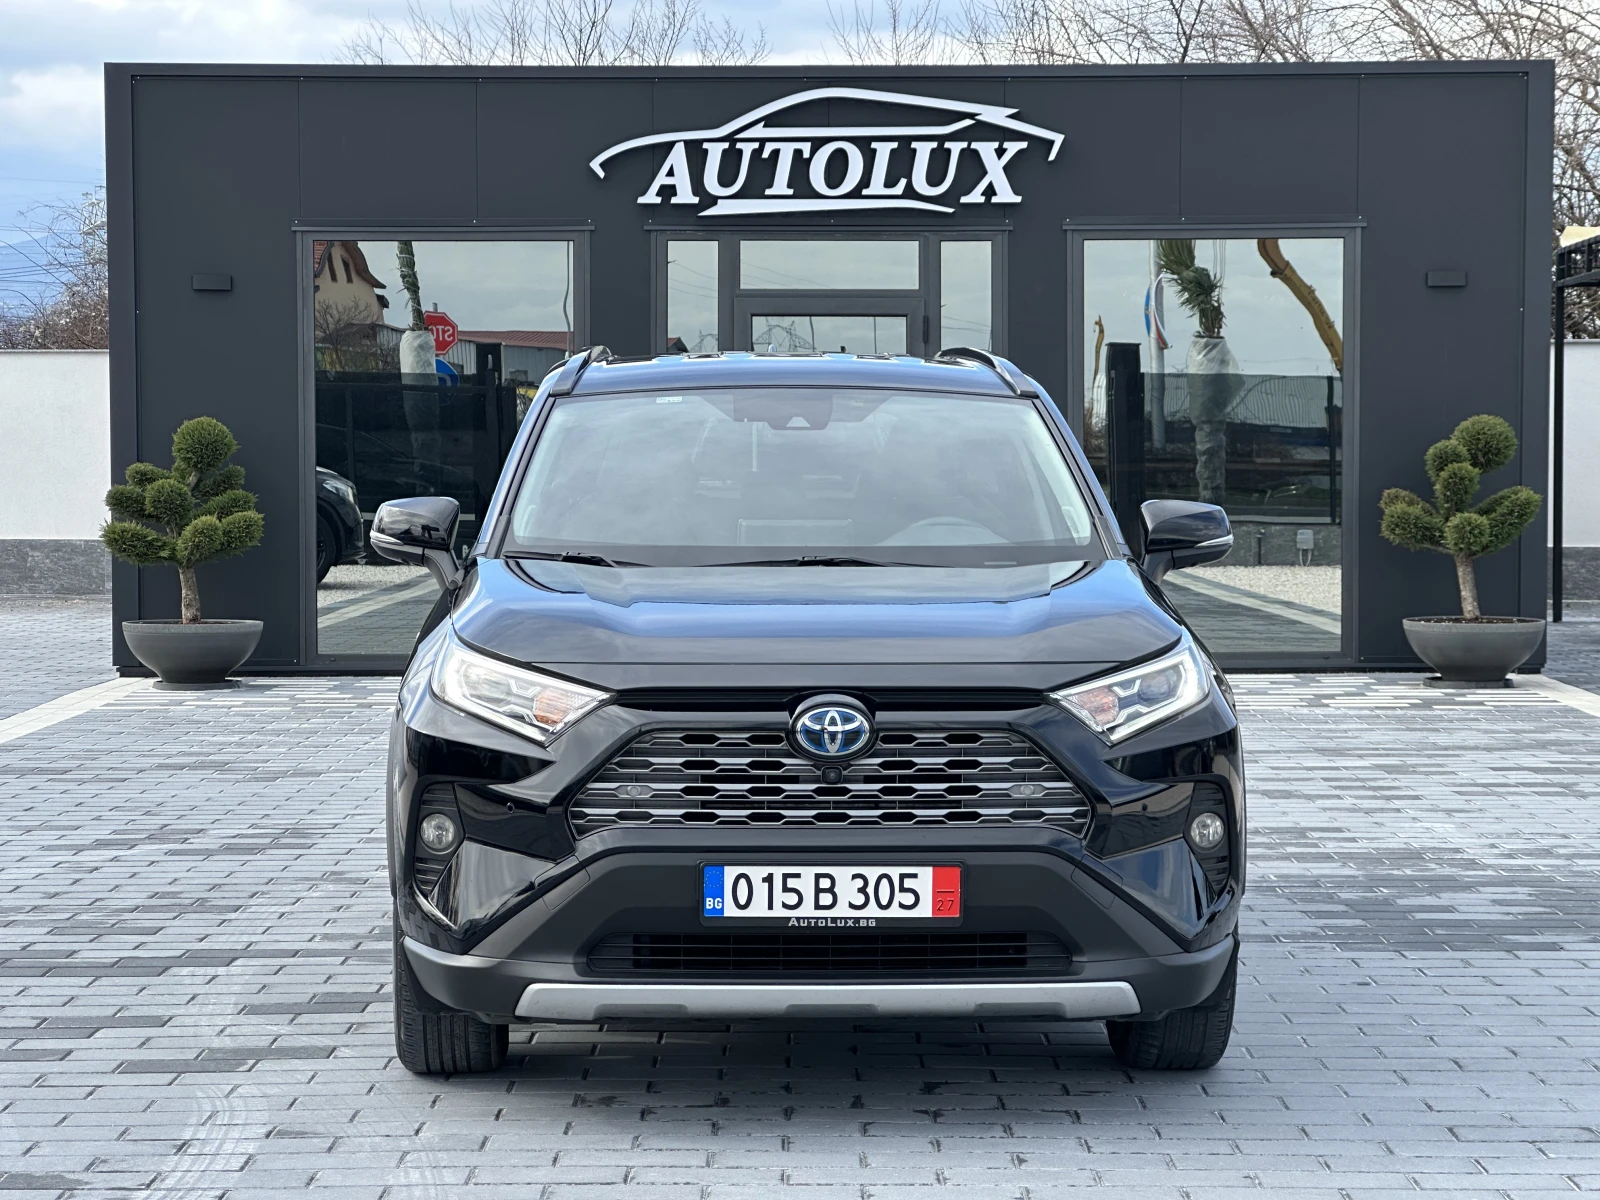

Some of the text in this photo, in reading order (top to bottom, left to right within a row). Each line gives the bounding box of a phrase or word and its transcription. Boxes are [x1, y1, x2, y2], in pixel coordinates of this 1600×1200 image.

[637, 141, 1027, 204] AUTOLUX
[705, 897, 723, 910] BG
[936, 898, 954, 911] 27
